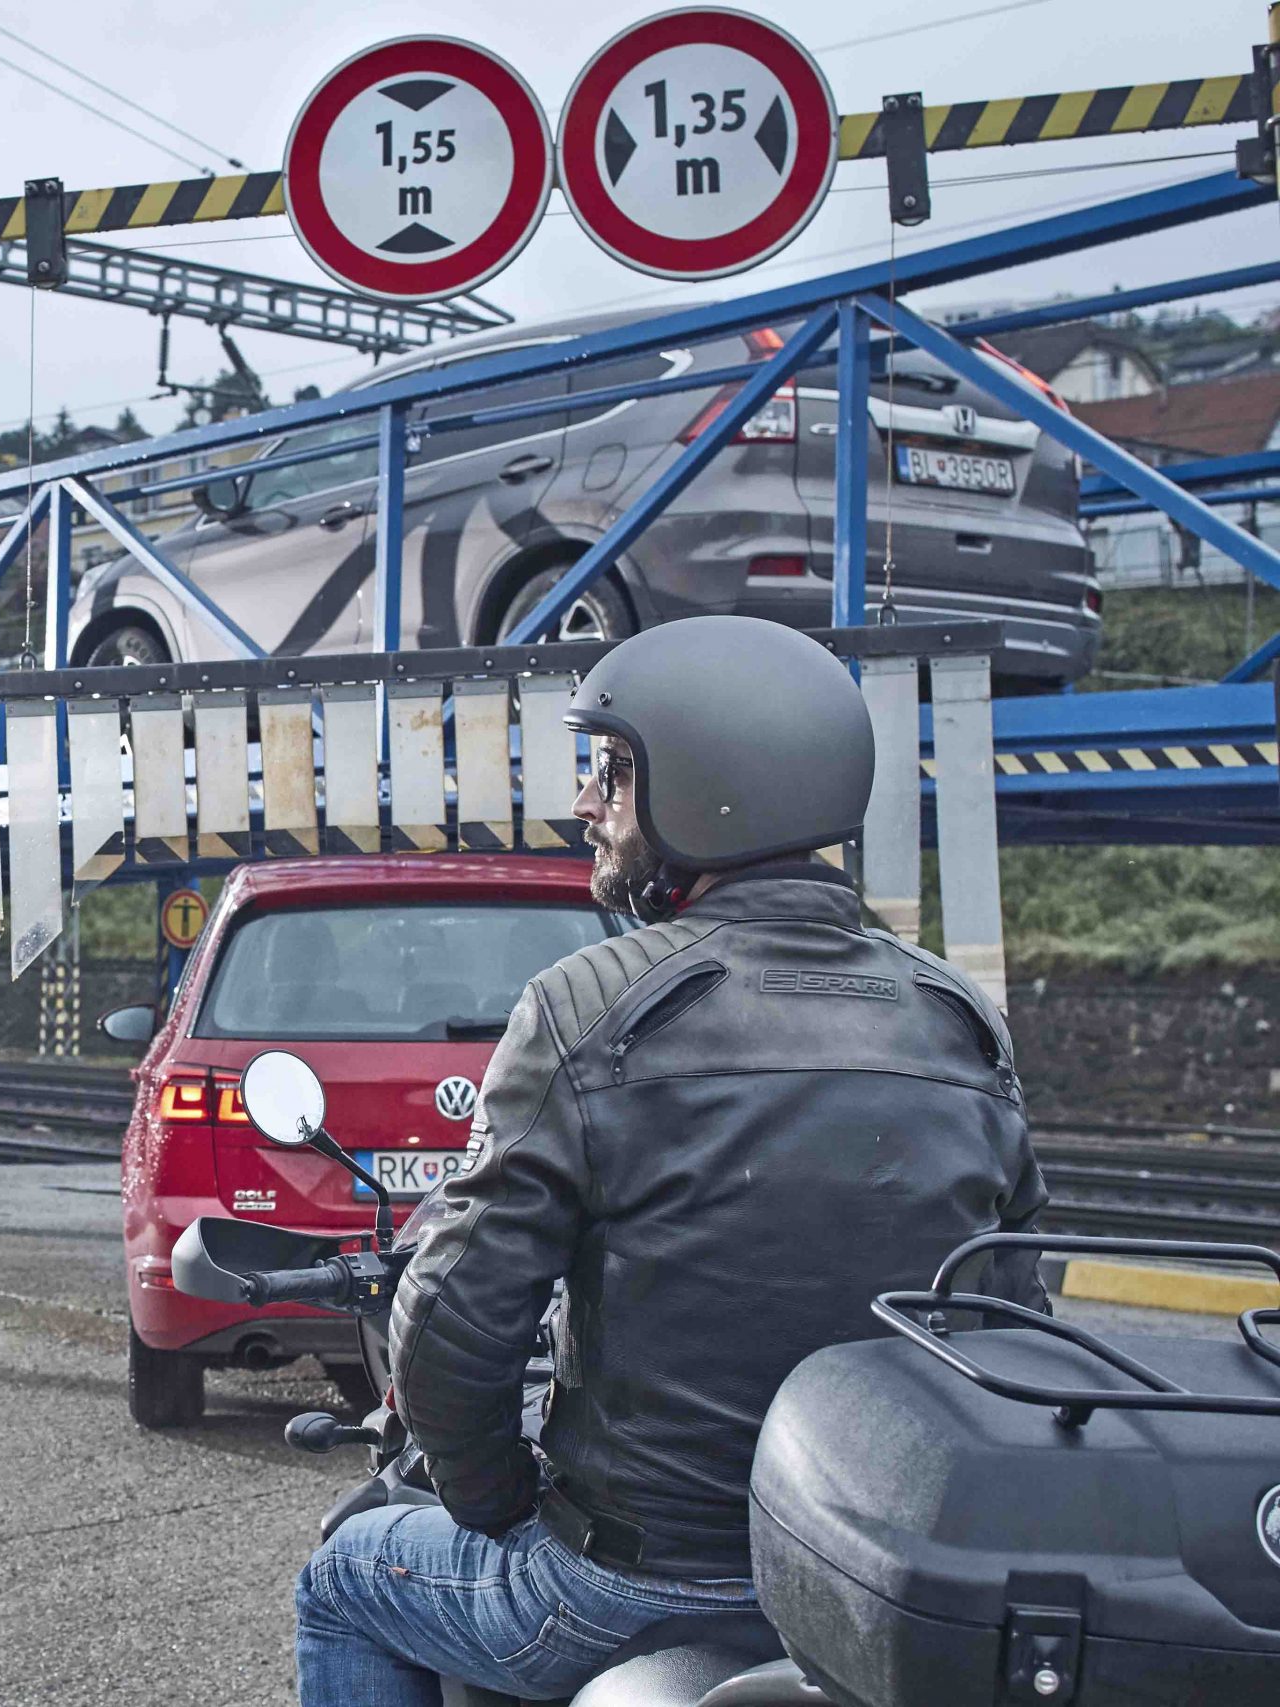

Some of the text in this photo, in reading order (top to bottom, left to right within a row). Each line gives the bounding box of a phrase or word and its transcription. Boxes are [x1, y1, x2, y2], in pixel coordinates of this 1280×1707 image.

[644, 79, 748, 147] 1,35
[375, 120, 457, 174] 1,55
[675, 156, 721, 196] m
[398, 185, 433, 216] m
[801, 975, 895, 995] SPARK
[378, 1156, 420, 1188] RK
